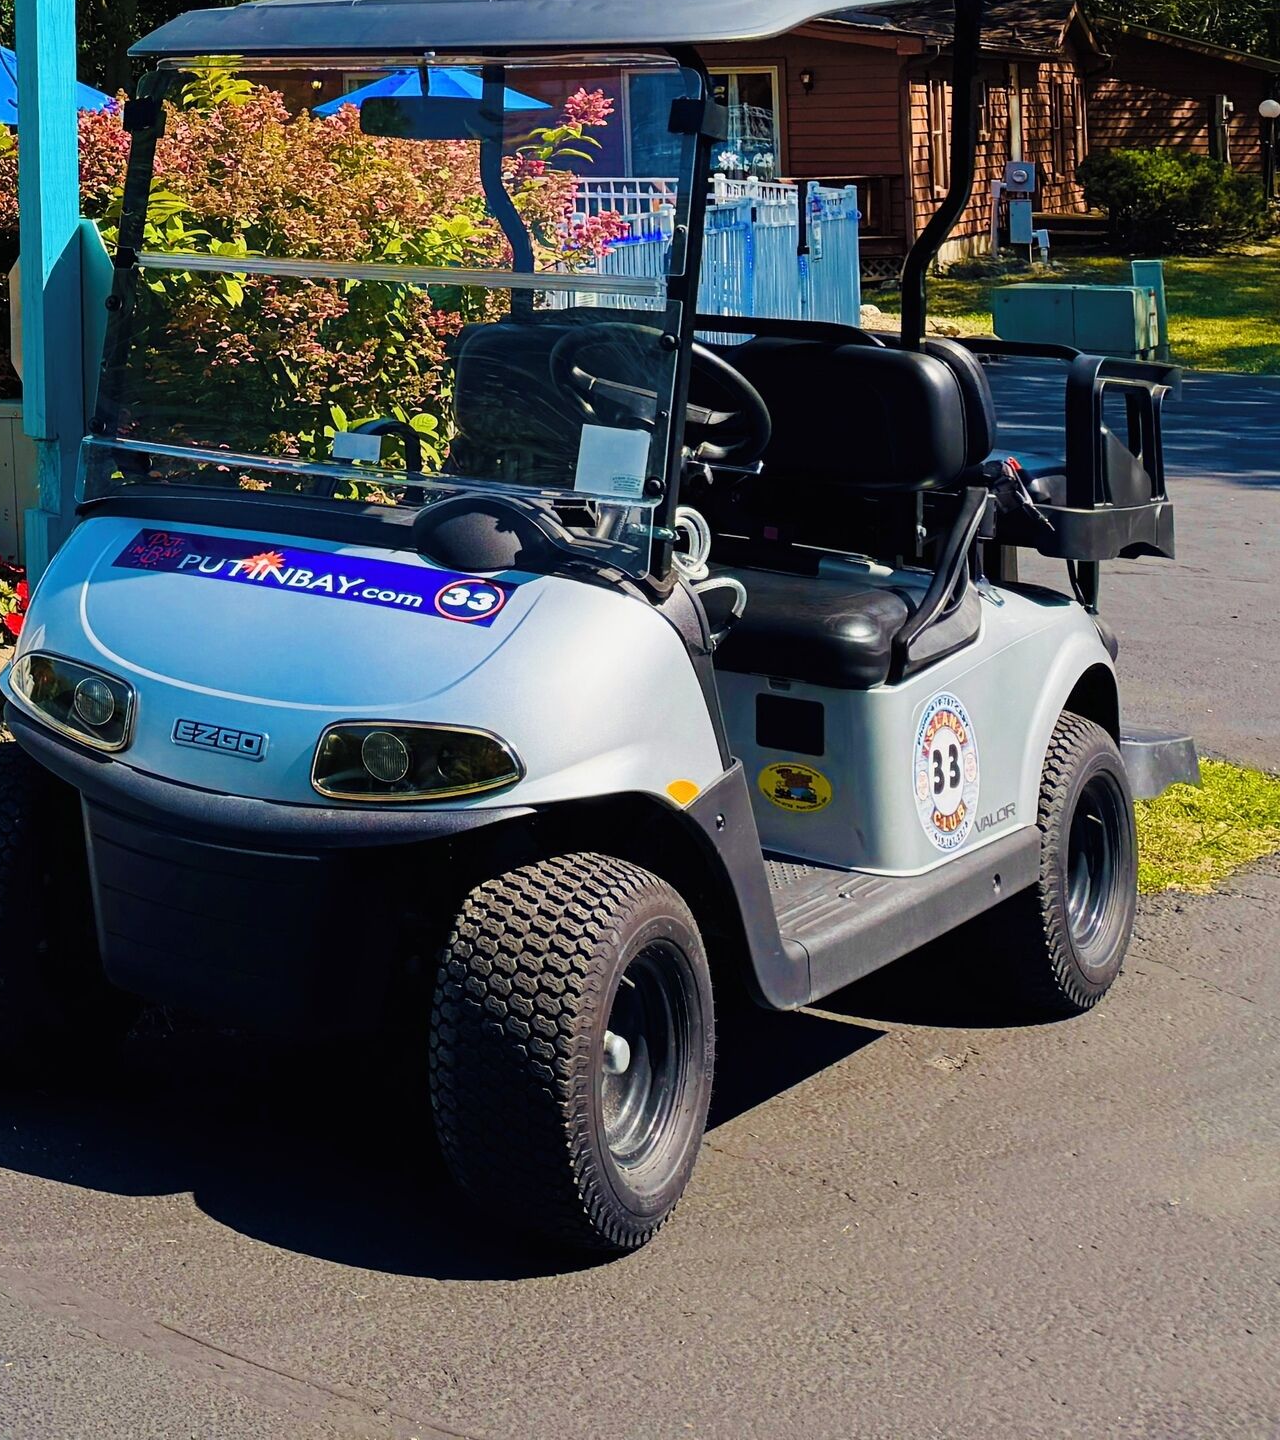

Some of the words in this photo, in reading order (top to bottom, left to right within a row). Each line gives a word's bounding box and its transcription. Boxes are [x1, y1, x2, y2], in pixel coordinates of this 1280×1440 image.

[177, 553, 423, 607] PUTINBAY.com
[441, 587, 497, 611] 33
[176, 721, 262, 752] EZGO
[923, 711, 965, 750] ISLAND
[933, 743, 961, 795] 33
[933, 804, 965, 831] CLUB
[975, 802, 1016, 832] VALOR
